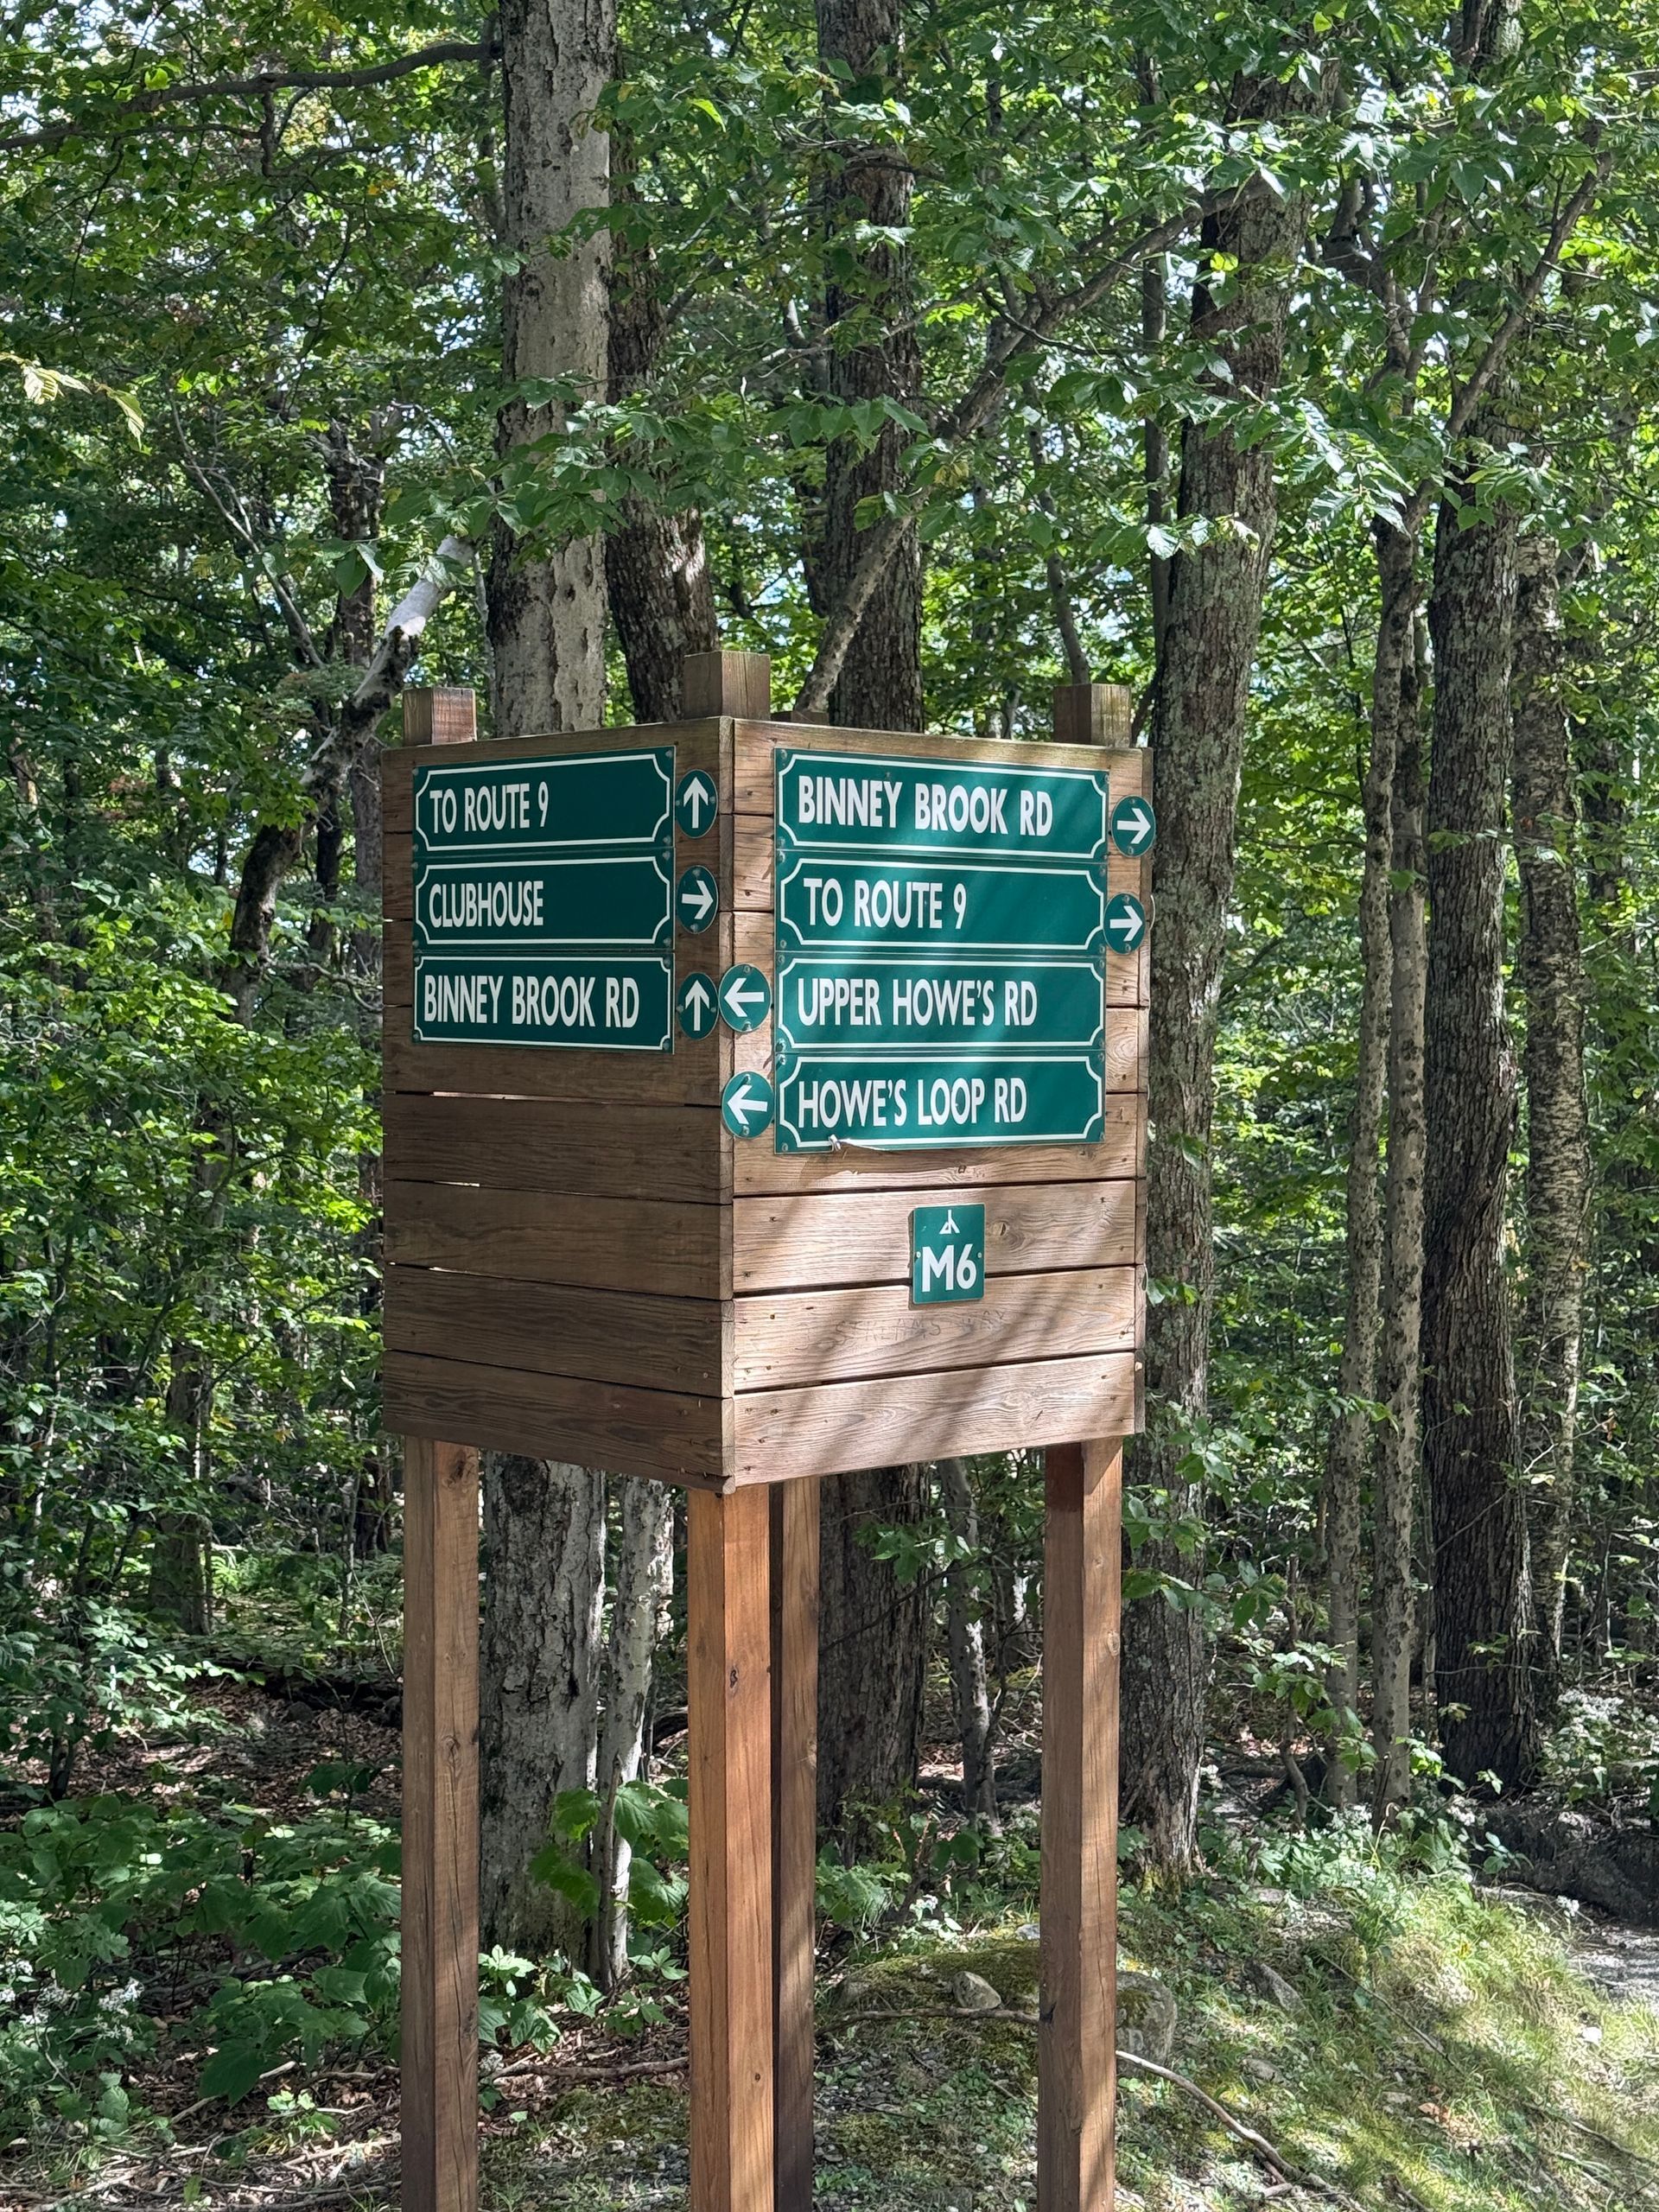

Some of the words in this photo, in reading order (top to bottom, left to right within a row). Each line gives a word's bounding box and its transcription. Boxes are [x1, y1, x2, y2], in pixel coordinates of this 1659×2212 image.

[429, 788, 457, 834] TO
[464, 782, 530, 832] ROUTE
[537, 781, 549, 828] 9
[798, 775, 902, 829] BINNEY
[914, 783, 1008, 836] BROOK
[1020, 790, 1052, 836] RD
[429, 880, 543, 928] CLUBHOUSE
[804, 878, 842, 927] TO
[854, 880, 943, 929] ROUTE
[953, 883, 967, 930] 9
[424, 975, 504, 1024] BINNEY
[512, 976, 595, 1027] BROOK
[606, 976, 639, 1028] RD
[798, 977, 880, 1027] UPPER
[893, 978, 994, 1027] HOWE'S
[1004, 981, 1037, 1027] RD
[798, 1078, 907, 1128] HOWE'S
[918, 1077, 985, 1127] LOOP
[994, 1077, 1027, 1123] RD
[922, 1243, 976, 1292] M6
